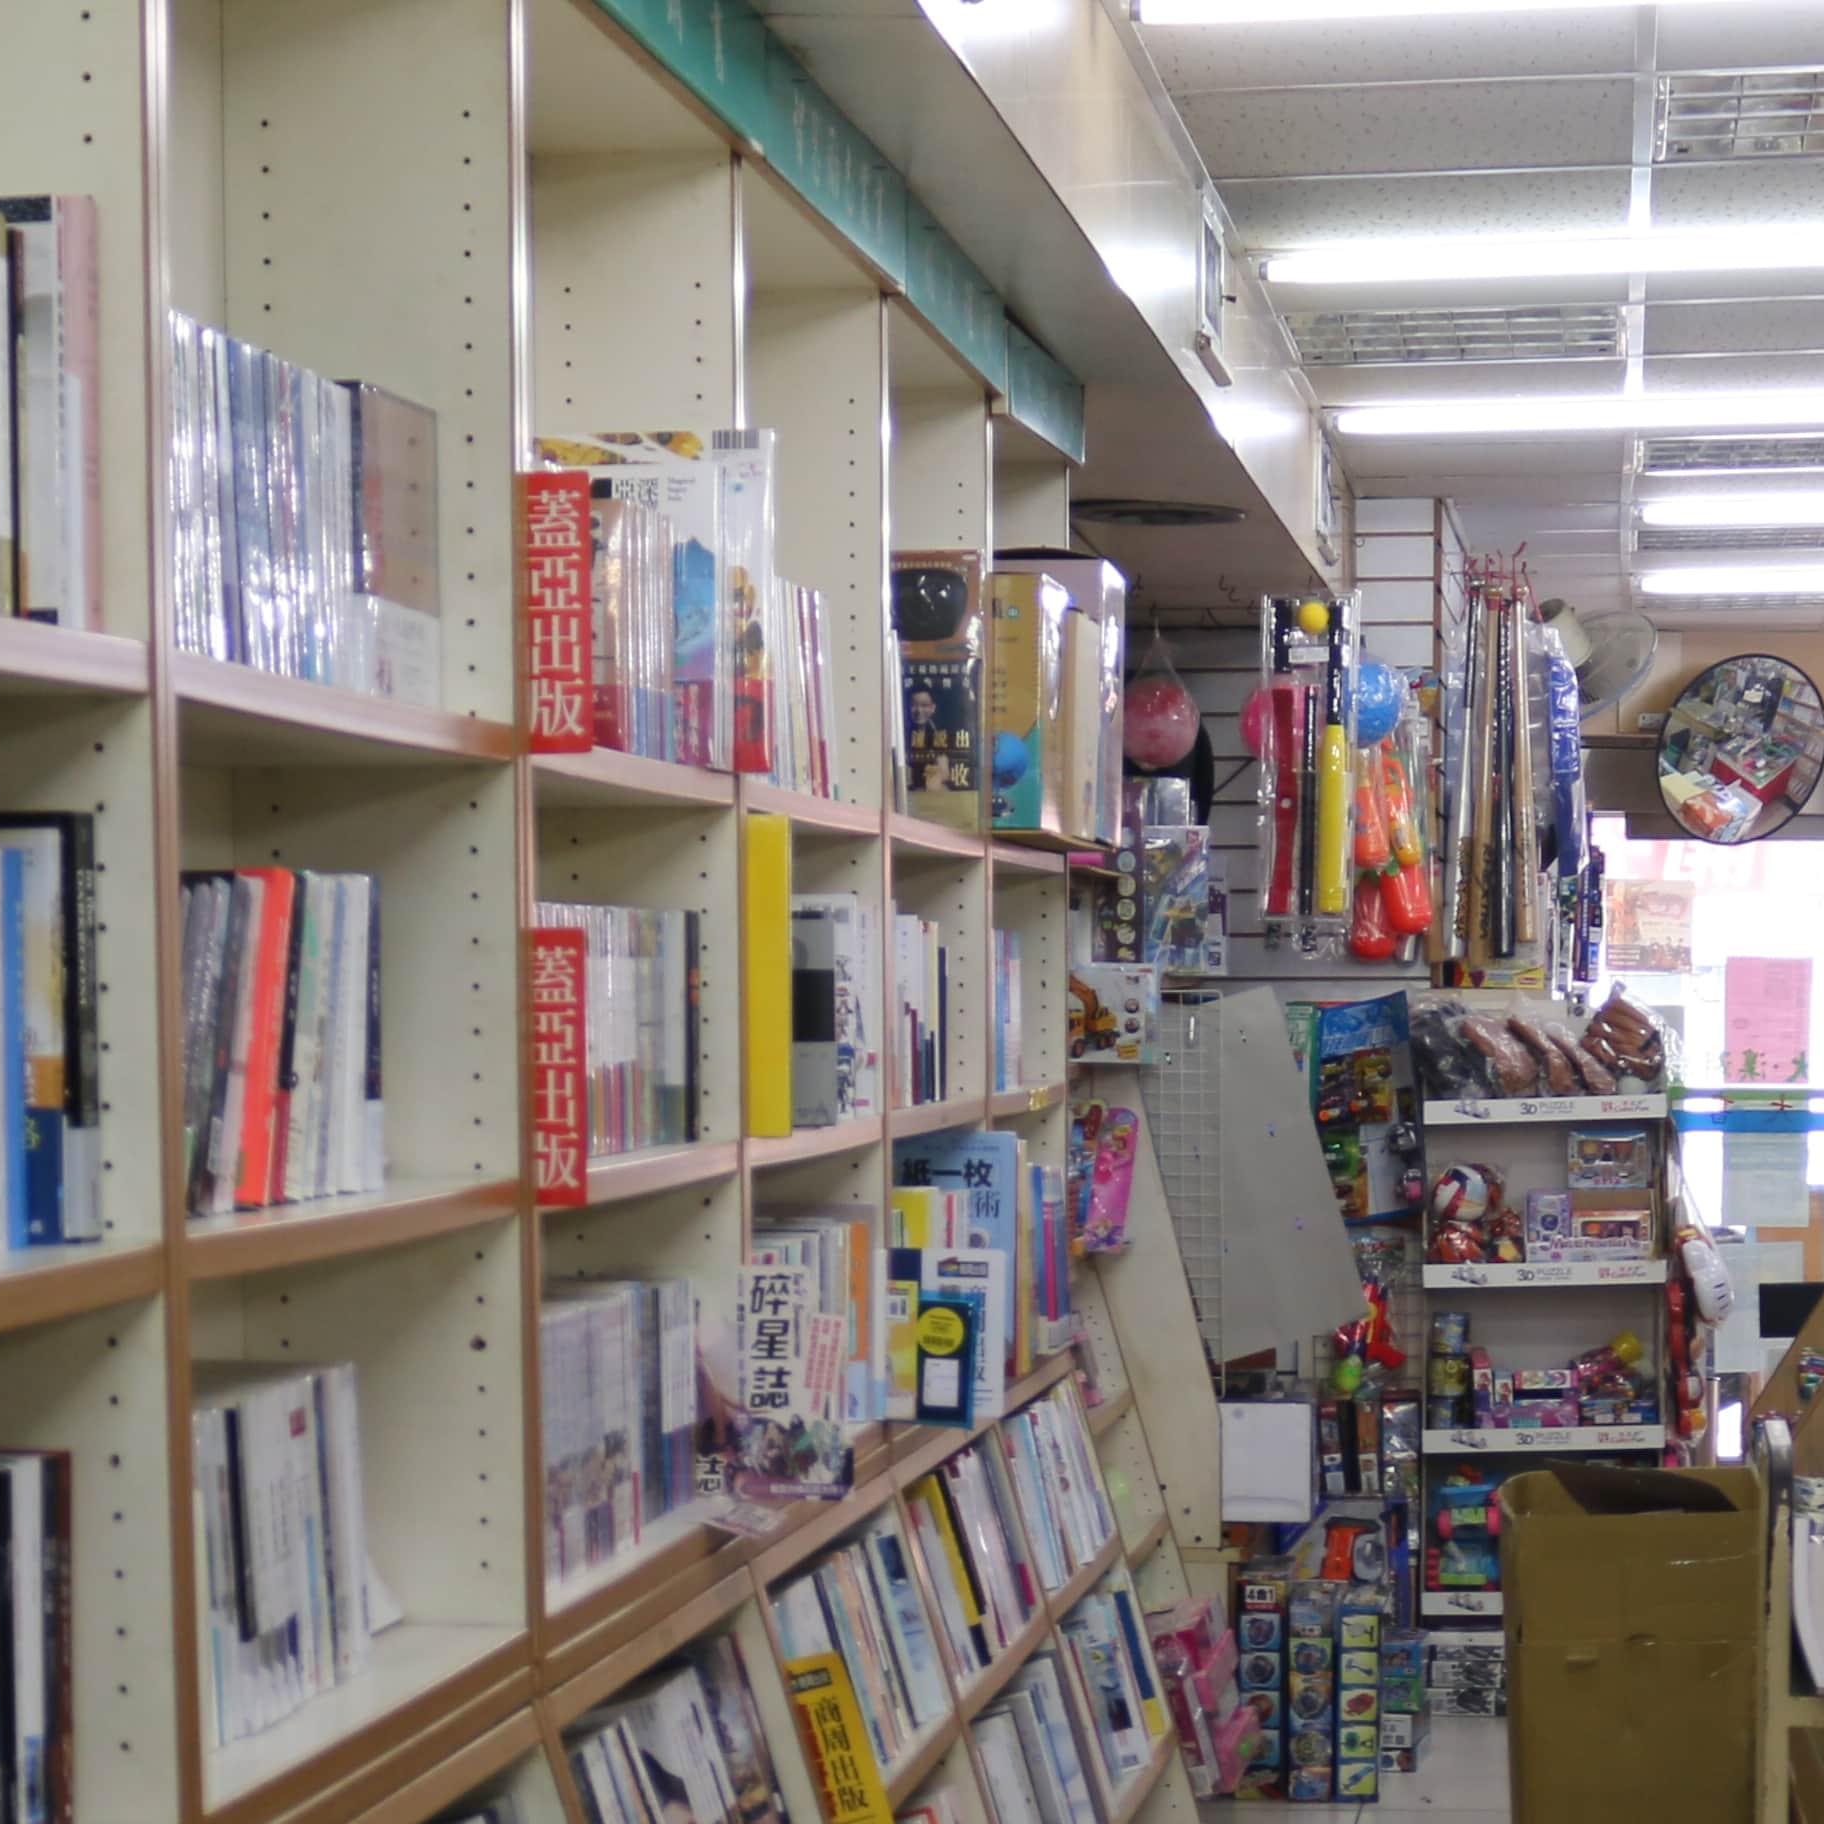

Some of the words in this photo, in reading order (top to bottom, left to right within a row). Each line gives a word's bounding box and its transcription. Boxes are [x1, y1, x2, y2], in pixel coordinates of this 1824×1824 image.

[527, 491, 585, 738] 蓋亞出版
[813, 1695, 870, 1813] 商周出版
